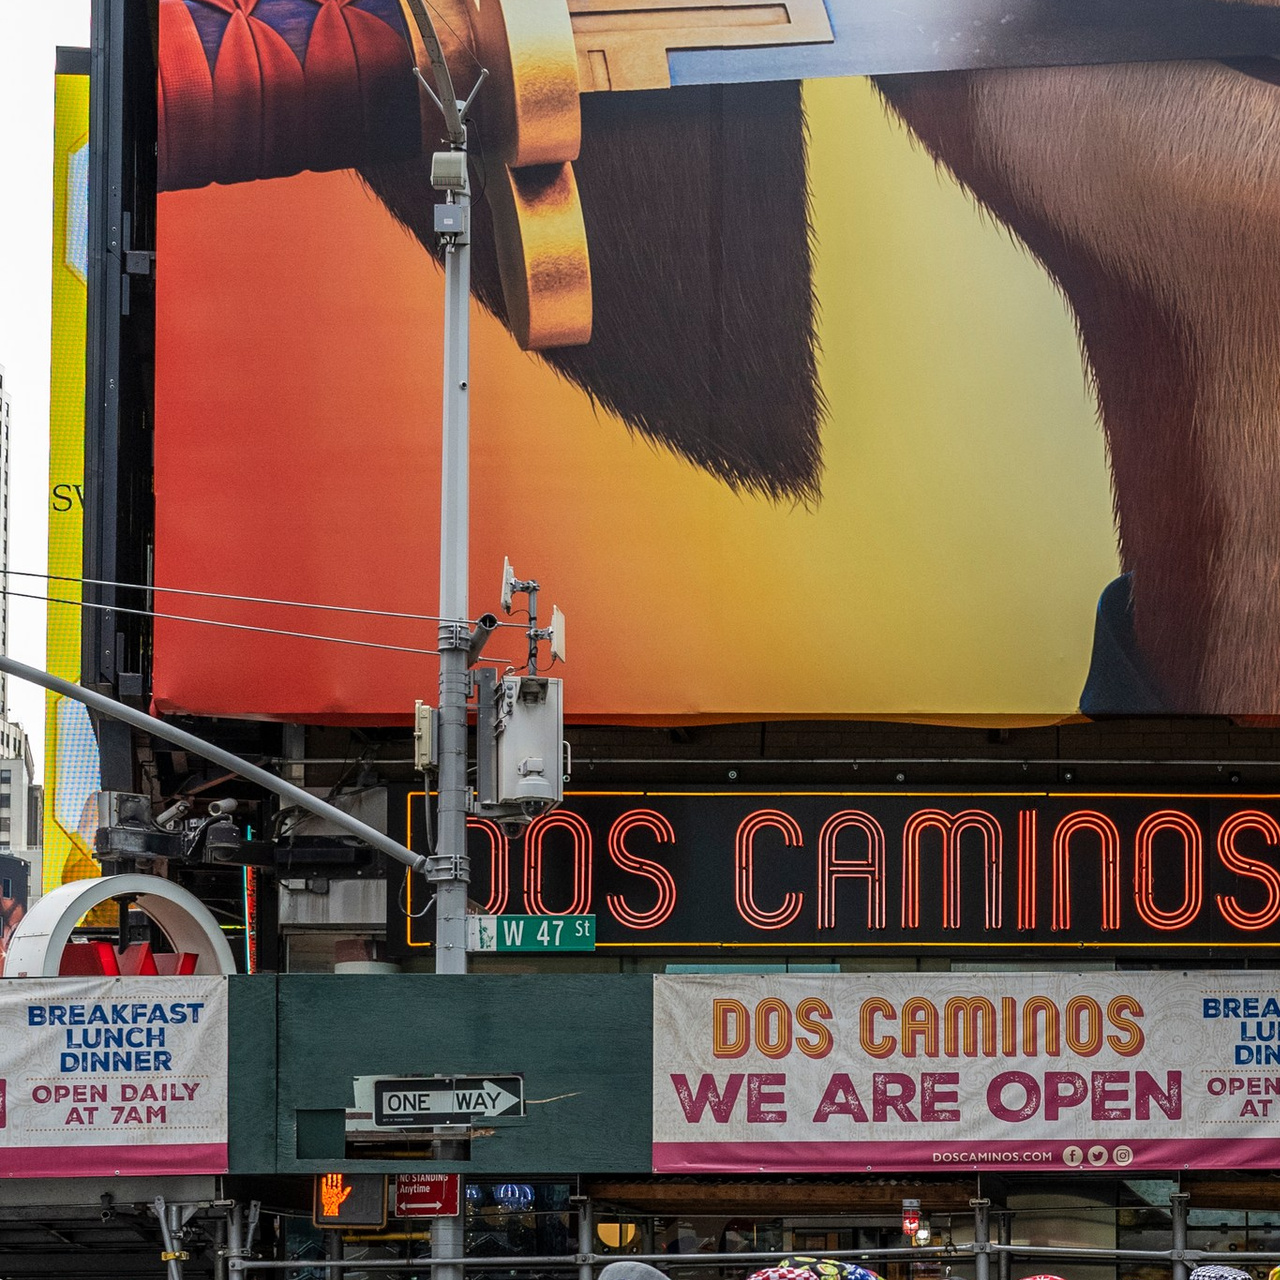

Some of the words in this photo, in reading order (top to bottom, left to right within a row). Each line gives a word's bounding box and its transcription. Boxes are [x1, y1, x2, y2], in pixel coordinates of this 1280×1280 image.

[502, 920, 524, 946] W
[536, 920, 564, 946] 47
[574, 920, 590, 937] St
[28, 1002, 205, 1026] BREAKFAST
[66, 1027, 166, 1049] LUNCH
[712, 996, 834, 1060] DOS
[859, 995, 1146, 1060] CAMINOS
[60, 1051, 172, 1073] DINNER
[32, 1084, 108, 1104] OPEN
[120, 1082, 201, 1102] DAILY
[387, 1093, 430, 1112] ONE
[455, 1092, 501, 1110] WAY
[670, 1073, 787, 1124] WE
[812, 1072, 961, 1123] ARE
[986, 1070, 1182, 1123] OPEN
[64, 1106, 99, 1125] AT
[111, 1105, 167, 1125] 7AM
[1239, 1099, 1273, 1117] AT
[932, 1150, 1052, 1163] DOSCAMINOS.COM
[399, 1174, 411, 1182] NO
[411, 1174, 448, 1182] STANDING
[399, 1183, 431, 1195] Anytime
